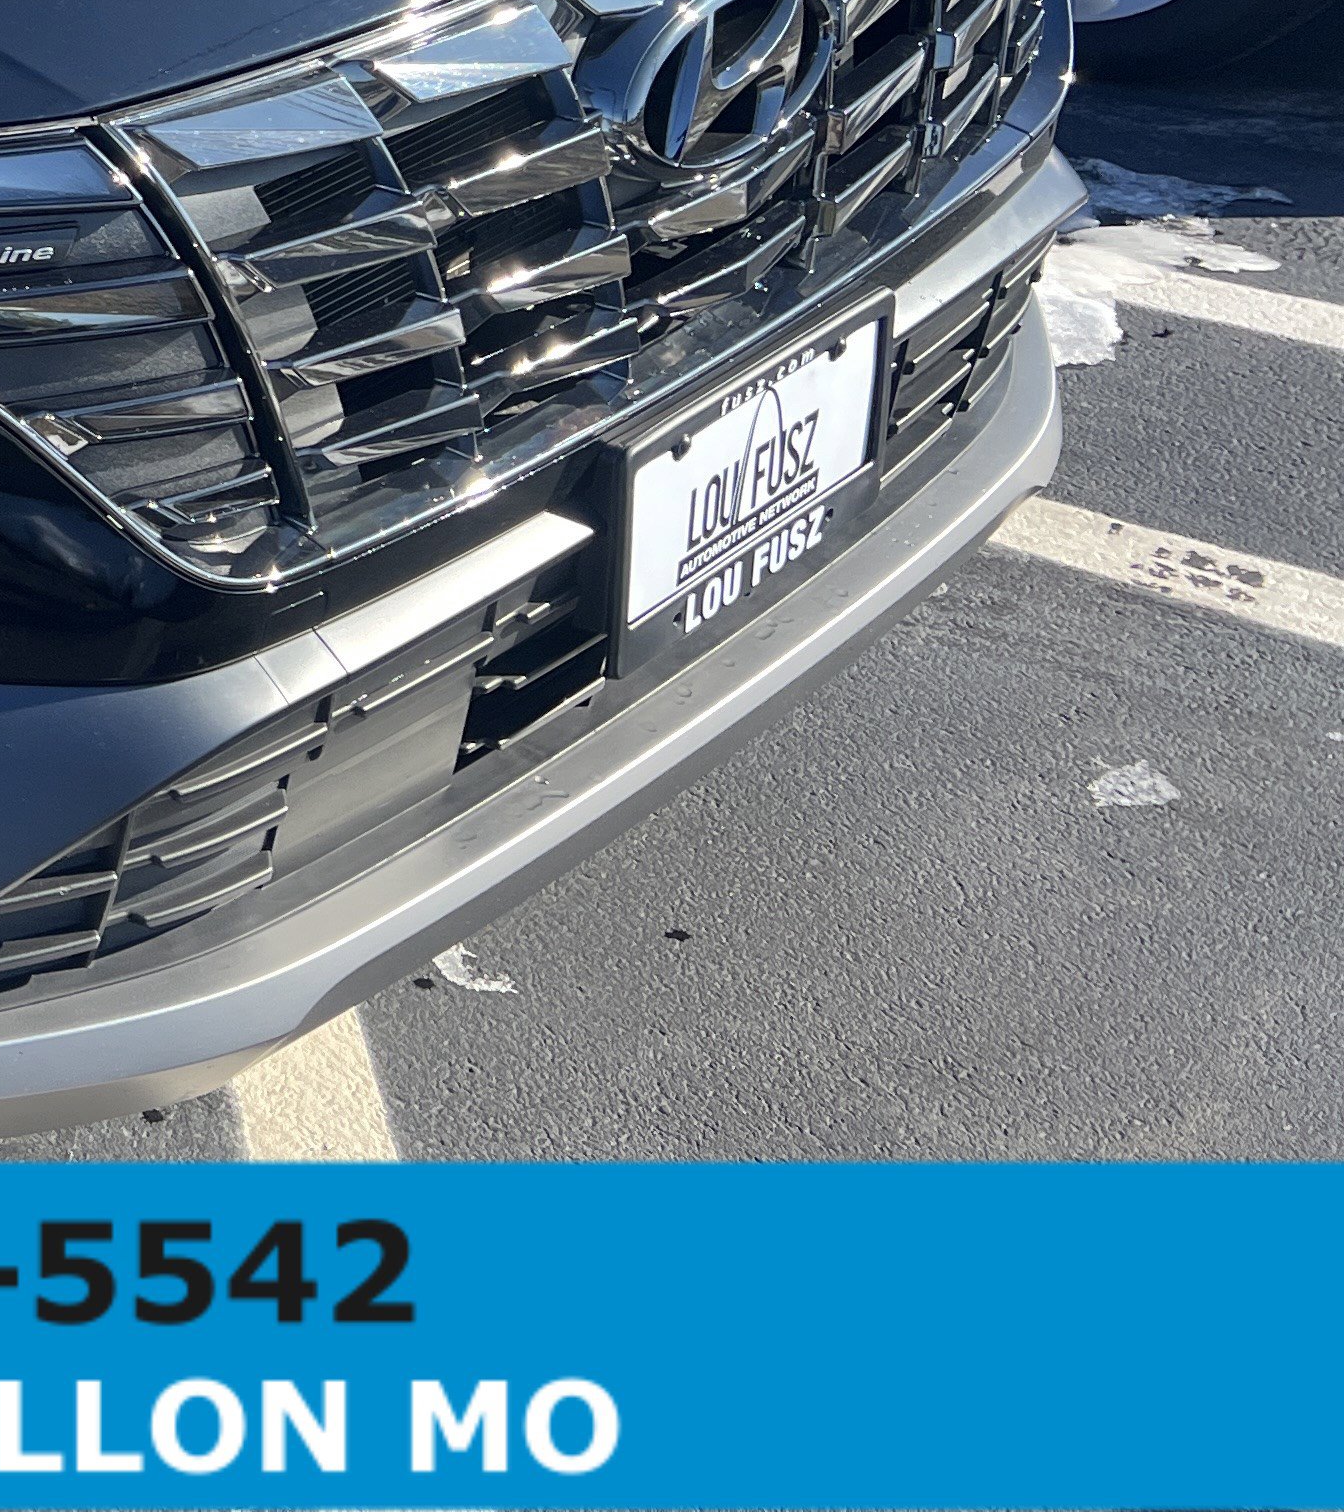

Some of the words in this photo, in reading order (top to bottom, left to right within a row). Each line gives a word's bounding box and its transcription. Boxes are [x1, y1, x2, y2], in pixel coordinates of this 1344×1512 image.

[721, 347, 815, 417] fusz.com
[680, 516, 757, 579] AUTOMOTIVE
[759, 476, 817, 526] NETWORK
[687, 459, 740, 553] LOU
[751, 408, 819, 509] FUSZ
[684, 561, 743, 634] LOU
[752, 505, 826, 587] FUSZ
